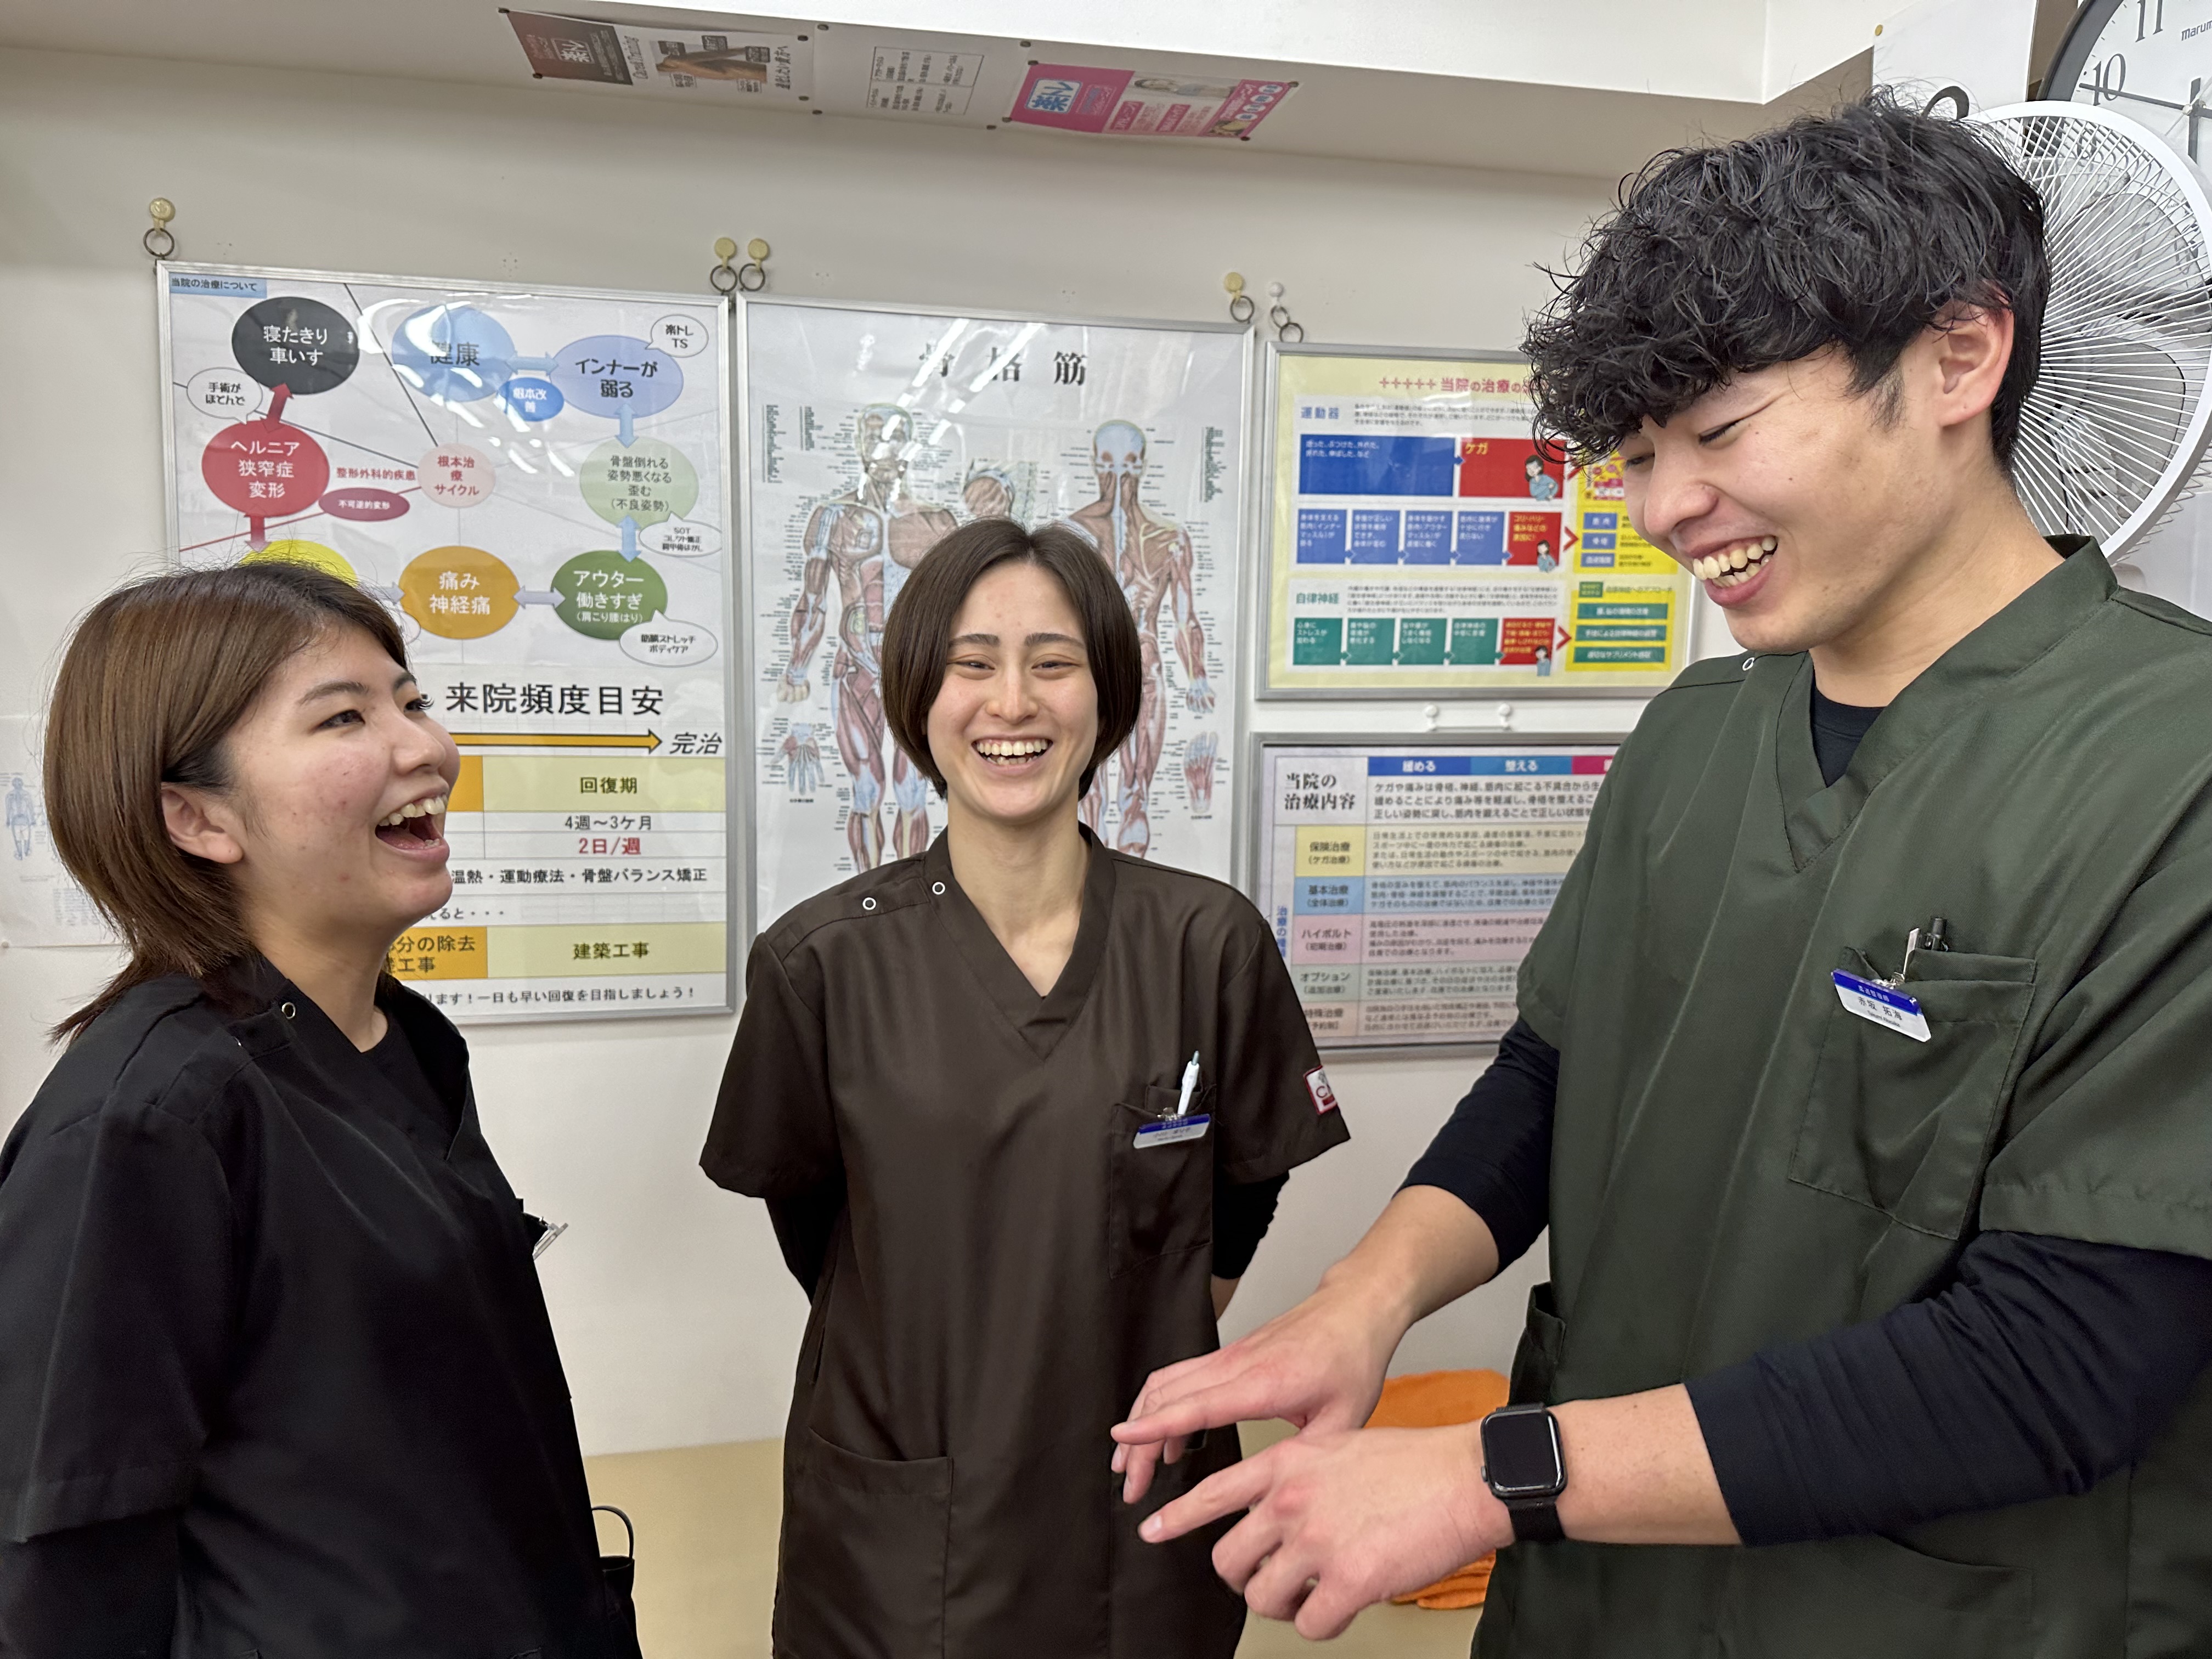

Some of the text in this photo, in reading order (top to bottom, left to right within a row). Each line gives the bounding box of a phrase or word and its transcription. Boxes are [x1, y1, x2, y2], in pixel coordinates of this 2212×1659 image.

[2093, 54, 2126, 106] 10
[1031, 81, 1075, 111] 楽トレ
[172, 278, 257, 292] 当院の治療について
[263, 325, 328, 345] 寝たきり
[672, 338, 688, 349] TS
[270, 348, 323, 365] 車いす
[430, 342, 480, 368] 健康
[575, 358, 658, 378] インナーが
[208, 382, 241, 393] 手術が
[601, 379, 634, 399] 弱る
[1441, 377, 1536, 393] 当院の治療の
[205, 394, 245, 407] ほとんど
[1300, 406, 1340, 420] 運動器
[231, 441, 300, 456] ヘルニア
[1465, 442, 1489, 456] ケガ
[238, 460, 295, 478] 狭窄症
[437, 455, 475, 469] 根本治
[610, 455, 669, 470] 骨盤倒れる
[336, 467, 416, 481] 整形外科的疾患
[607, 470, 672, 484] 姿勢悪くなる
[249, 482, 286, 499] 変形
[435, 483, 480, 496] サイクル
[628, 484, 652, 496] 歪む
[439, 571, 480, 591] 痛み
[573, 569, 644, 588] アウター
[429, 595, 491, 616] 神経痛
[576, 591, 643, 610] 働きすぎ
[1296, 592, 1339, 605] 自律神経
[669, 732, 723, 755] 完治
[579, 776, 639, 794] 回復期
[1284, 772, 1337, 789] 当院の
[1283, 791, 1356, 811] 治療内容
[578, 837, 641, 855] 2日/週
[390, 935, 476, 953] 分の除去
[573, 941, 650, 960] 建築工事
[390, 957, 436, 973] 工事
